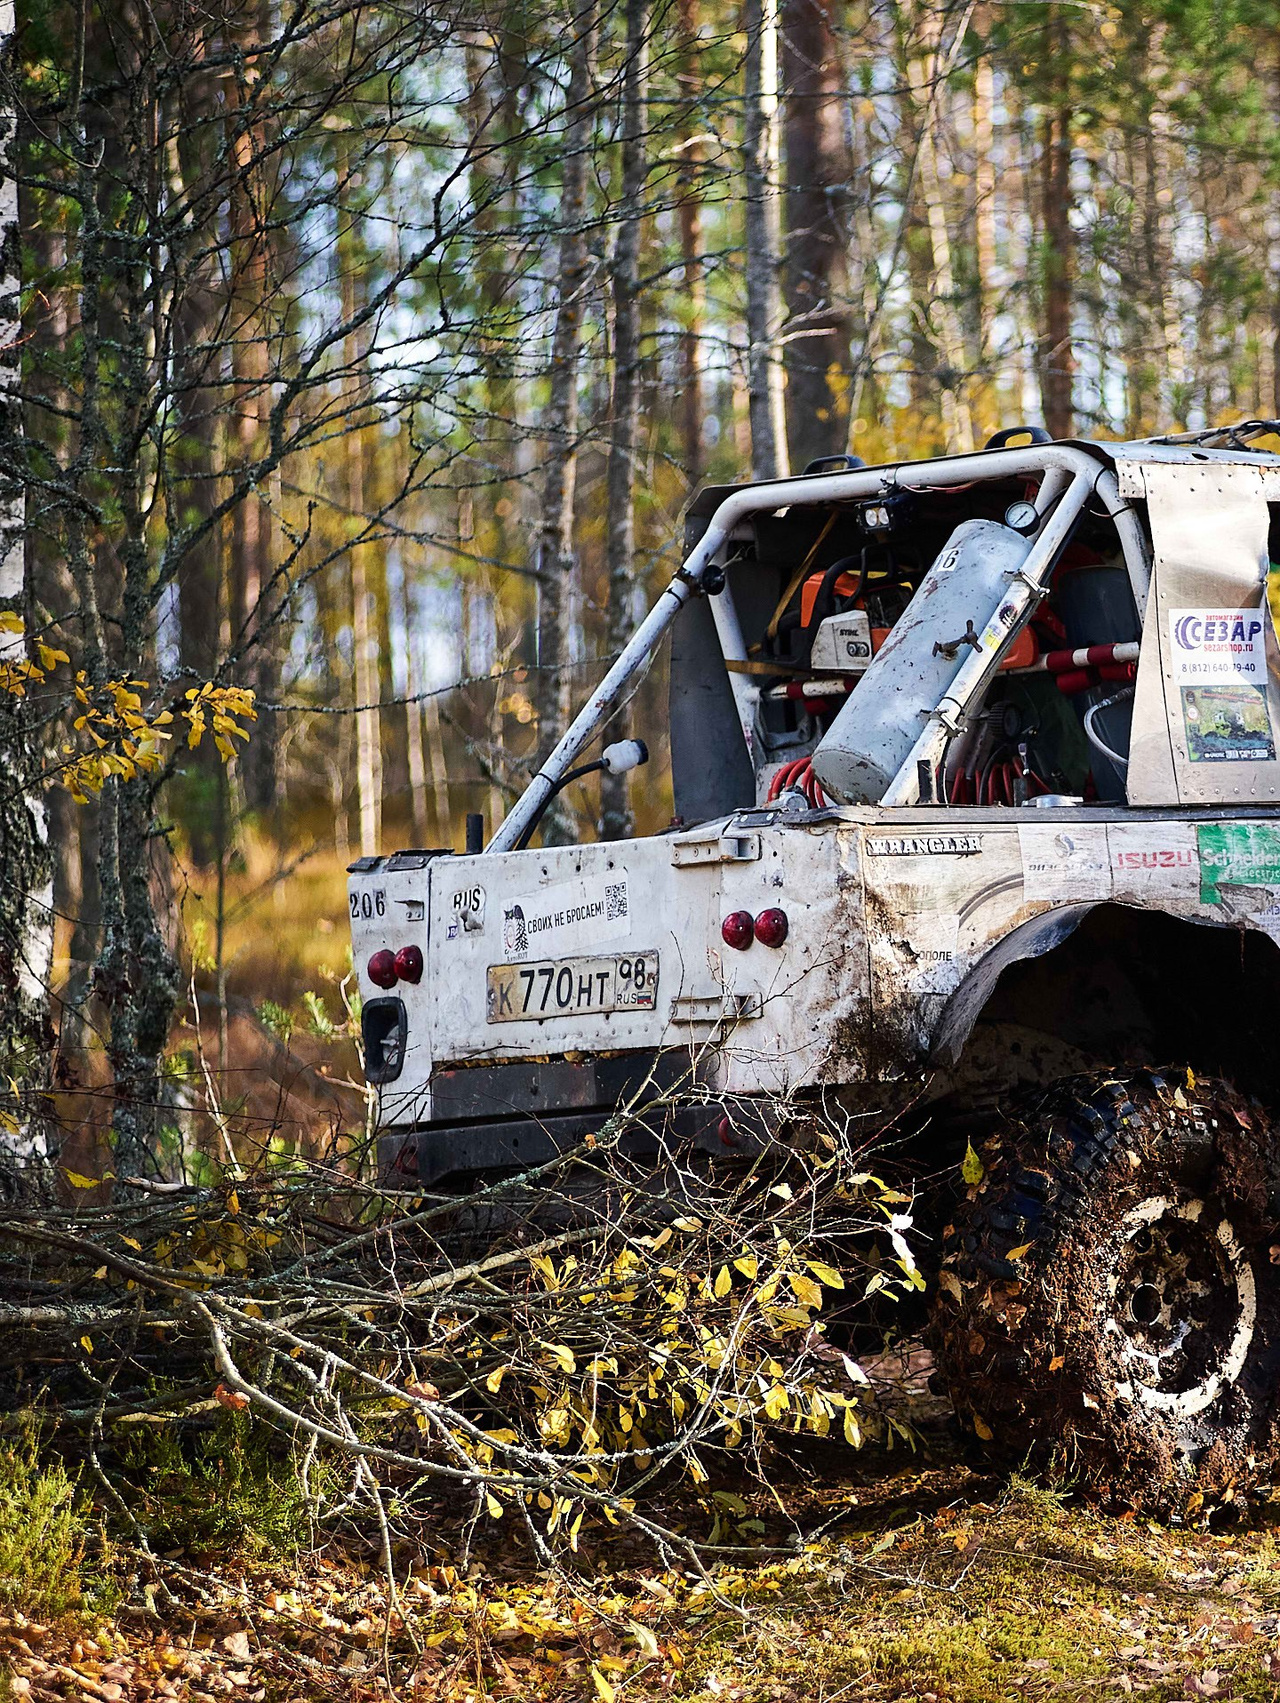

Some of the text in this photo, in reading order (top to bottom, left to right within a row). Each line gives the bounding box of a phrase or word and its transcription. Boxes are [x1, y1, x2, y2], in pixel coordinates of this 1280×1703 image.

[1191, 621, 1262, 642] СЕЗАР
[1204, 643, 1253, 654] sezarshop.ru
[1181, 663, 1255, 673] 8 (812) 640-79-40
[868, 837, 981, 854] WRANGLER
[1114, 851, 1192, 870] ISUZU
[1239, 869, 1280, 881] Electric
[350, 891, 385, 918] 206
[453, 887, 481, 912] RUS
[527, 901, 605, 934] СВОИХ НЕ БРОСАЕМ!
[619, 958, 646, 990] 98
[617, 993, 637, 1005] RUS
